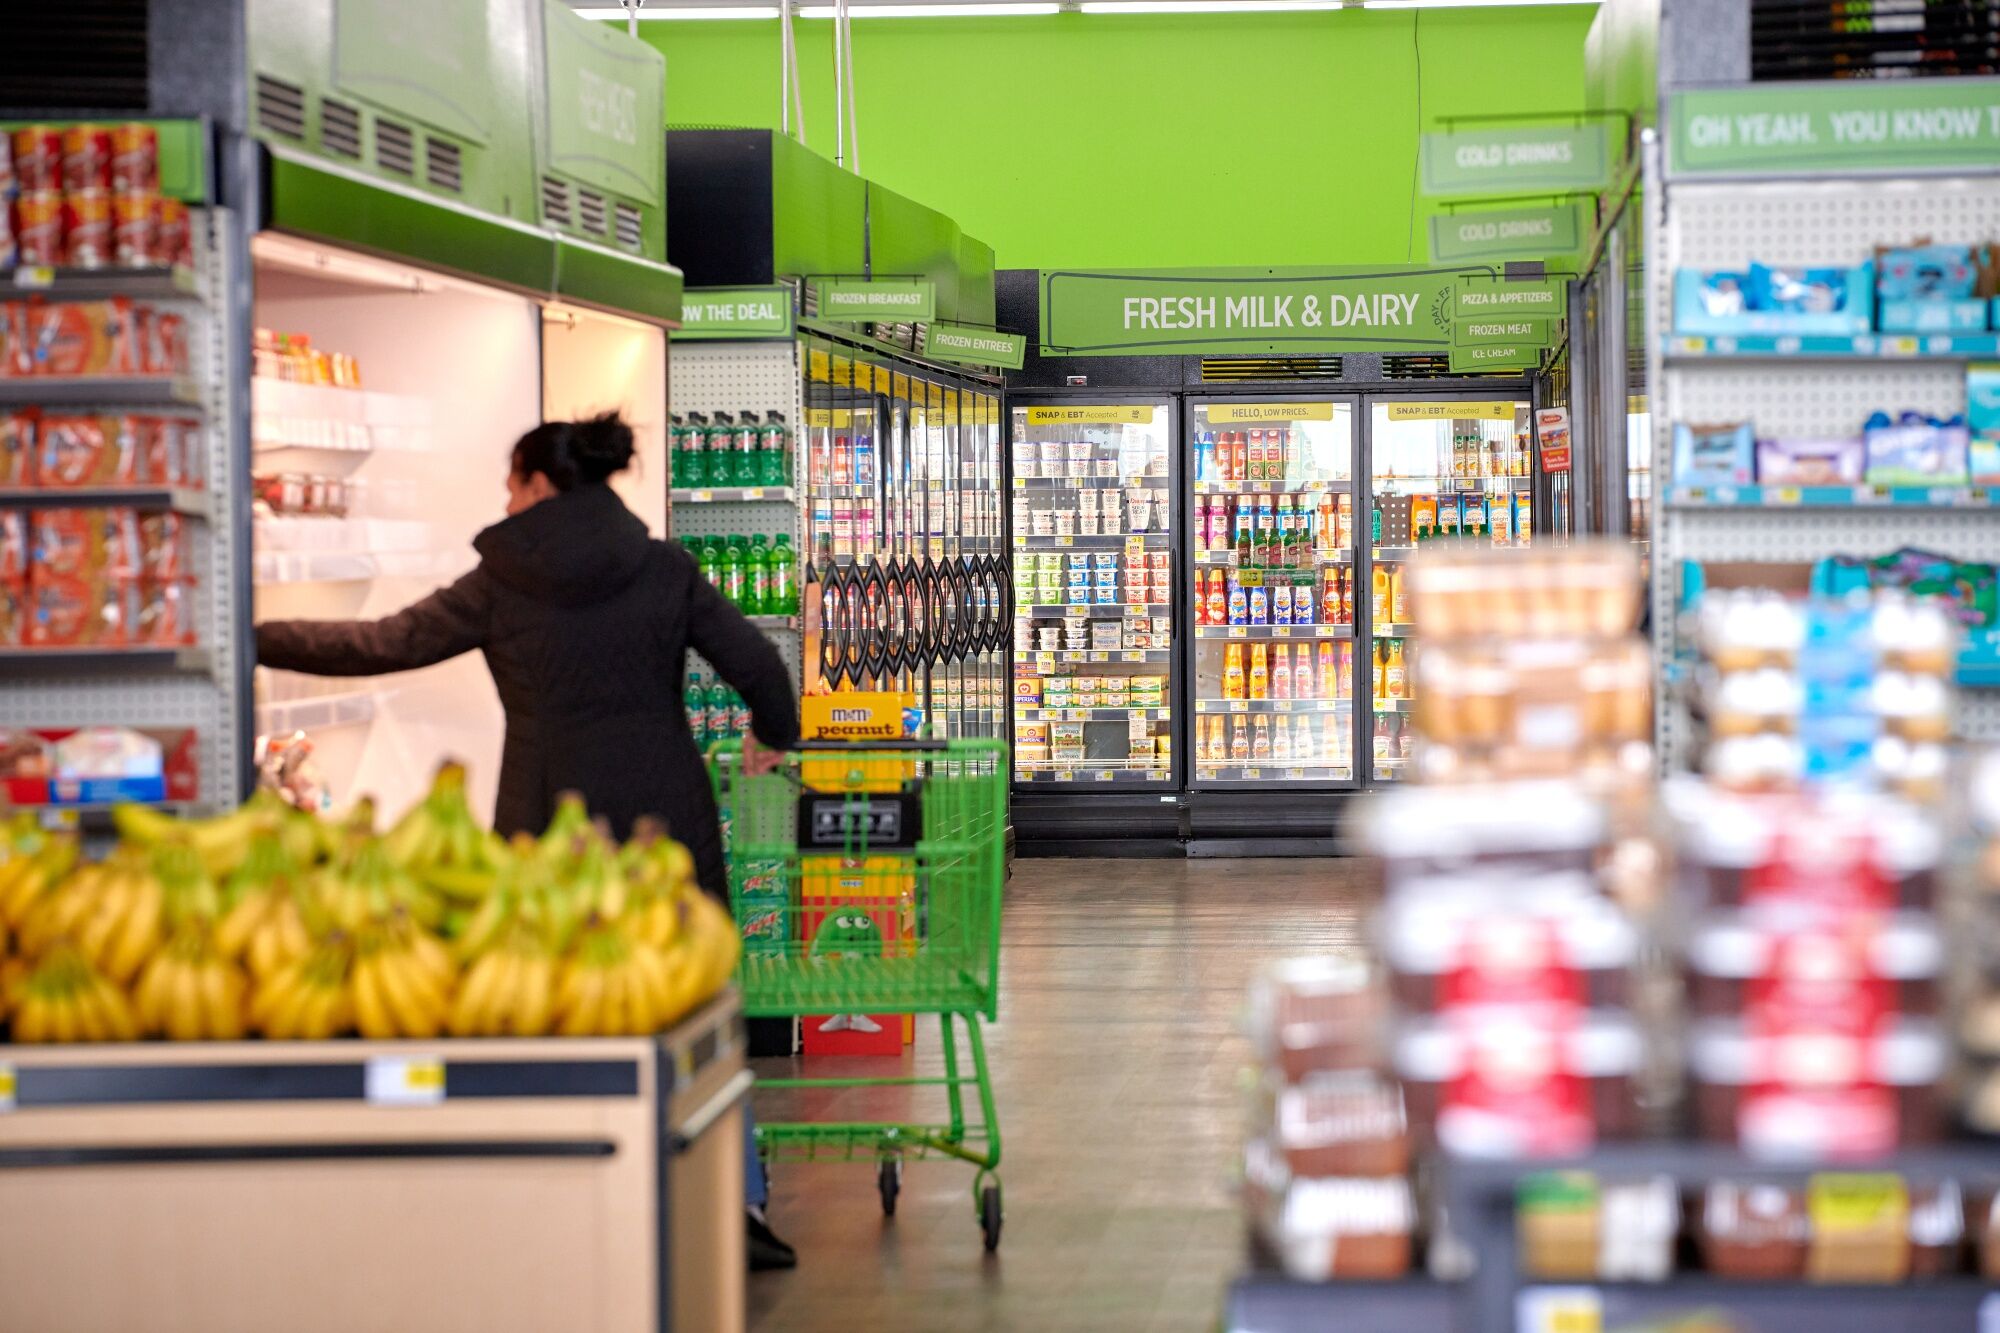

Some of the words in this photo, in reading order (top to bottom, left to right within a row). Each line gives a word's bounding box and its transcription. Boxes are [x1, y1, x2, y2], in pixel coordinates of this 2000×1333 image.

[1688, 113, 1733, 148] OH
[1735, 111, 1819, 146] YEAH.
[1829, 109, 1889, 145] YOU
[1892, 105, 1983, 141] KNOW
[1455, 145, 1503, 168] COLD
[1505, 141, 1573, 166] DRINKS
[1459, 223, 1497, 241] COLD
[830, 292, 866, 305] FROZEN
[868, 292, 922, 305] BREAKFAST
[1462, 293, 1489, 305] PIZZA
[1491, 293, 1498, 304] &
[1500, 291, 1553, 304] APPETIZERS
[706, 303, 734, 321] THE
[737, 302, 781, 320] DEAL.
[1124, 297, 1216, 329] FRESH
[1225, 295, 1294, 328] MILK
[1301, 294, 1322, 327] &
[1330, 293, 1420, 327] DAIRY
[1469, 324, 1506, 336] FROZEN
[1507, 323, 1532, 335] MEAT
[935, 333, 972, 349] FROZEN
[973, 339, 1013, 353] ENTREES
[1472, 349, 1486, 359] ICE
[1487, 348, 1517, 358] CREAM
[1035, 411, 1060, 419] SNAP
[1067, 411, 1084, 419] EBT
[1232, 408, 1263, 419] HELLO,
[1264, 408, 1280, 417] LOW
[1396, 407, 1421, 415] SNAP
[1428, 407, 1446, 415] EBT
[816, 723, 895, 738] peanut
